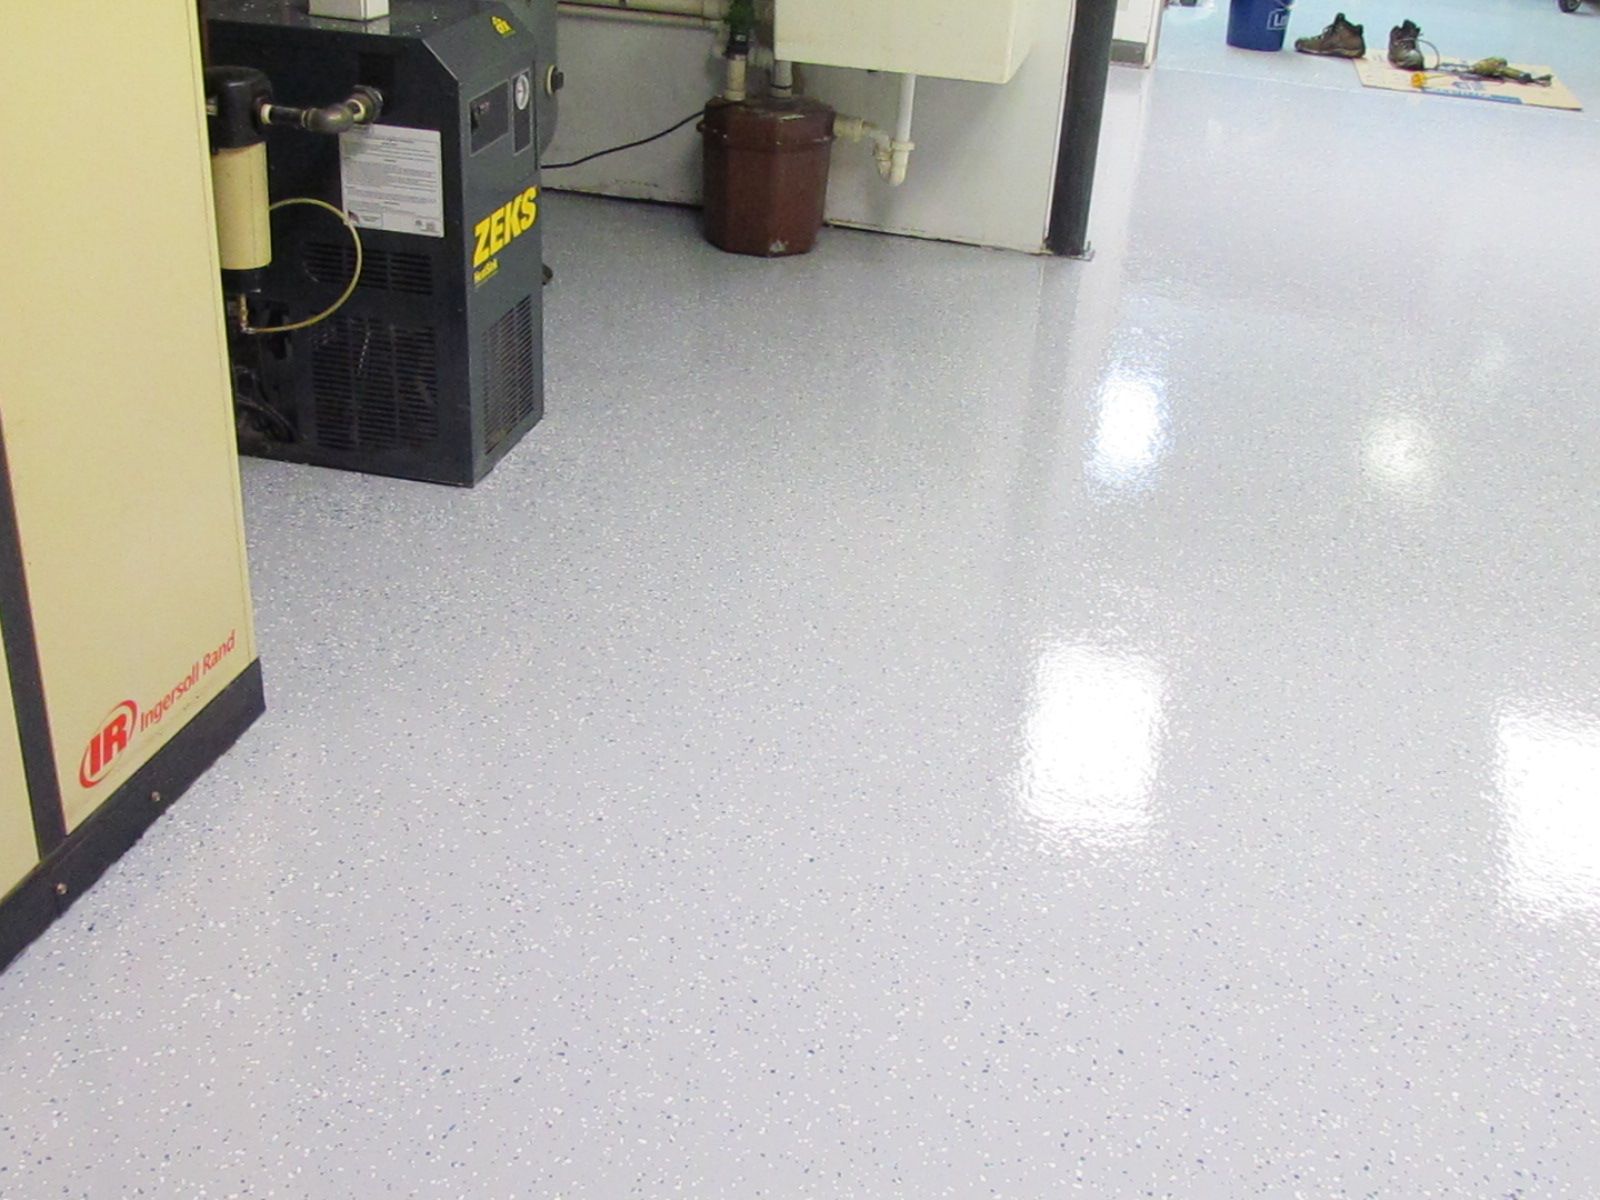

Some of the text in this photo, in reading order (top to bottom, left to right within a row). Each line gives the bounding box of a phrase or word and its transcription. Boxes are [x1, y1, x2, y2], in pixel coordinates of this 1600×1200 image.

[474, 186, 537, 267] ZEKS
[140, 629, 235, 732] Ingersoll Rand
[90, 713, 127, 777] IR
